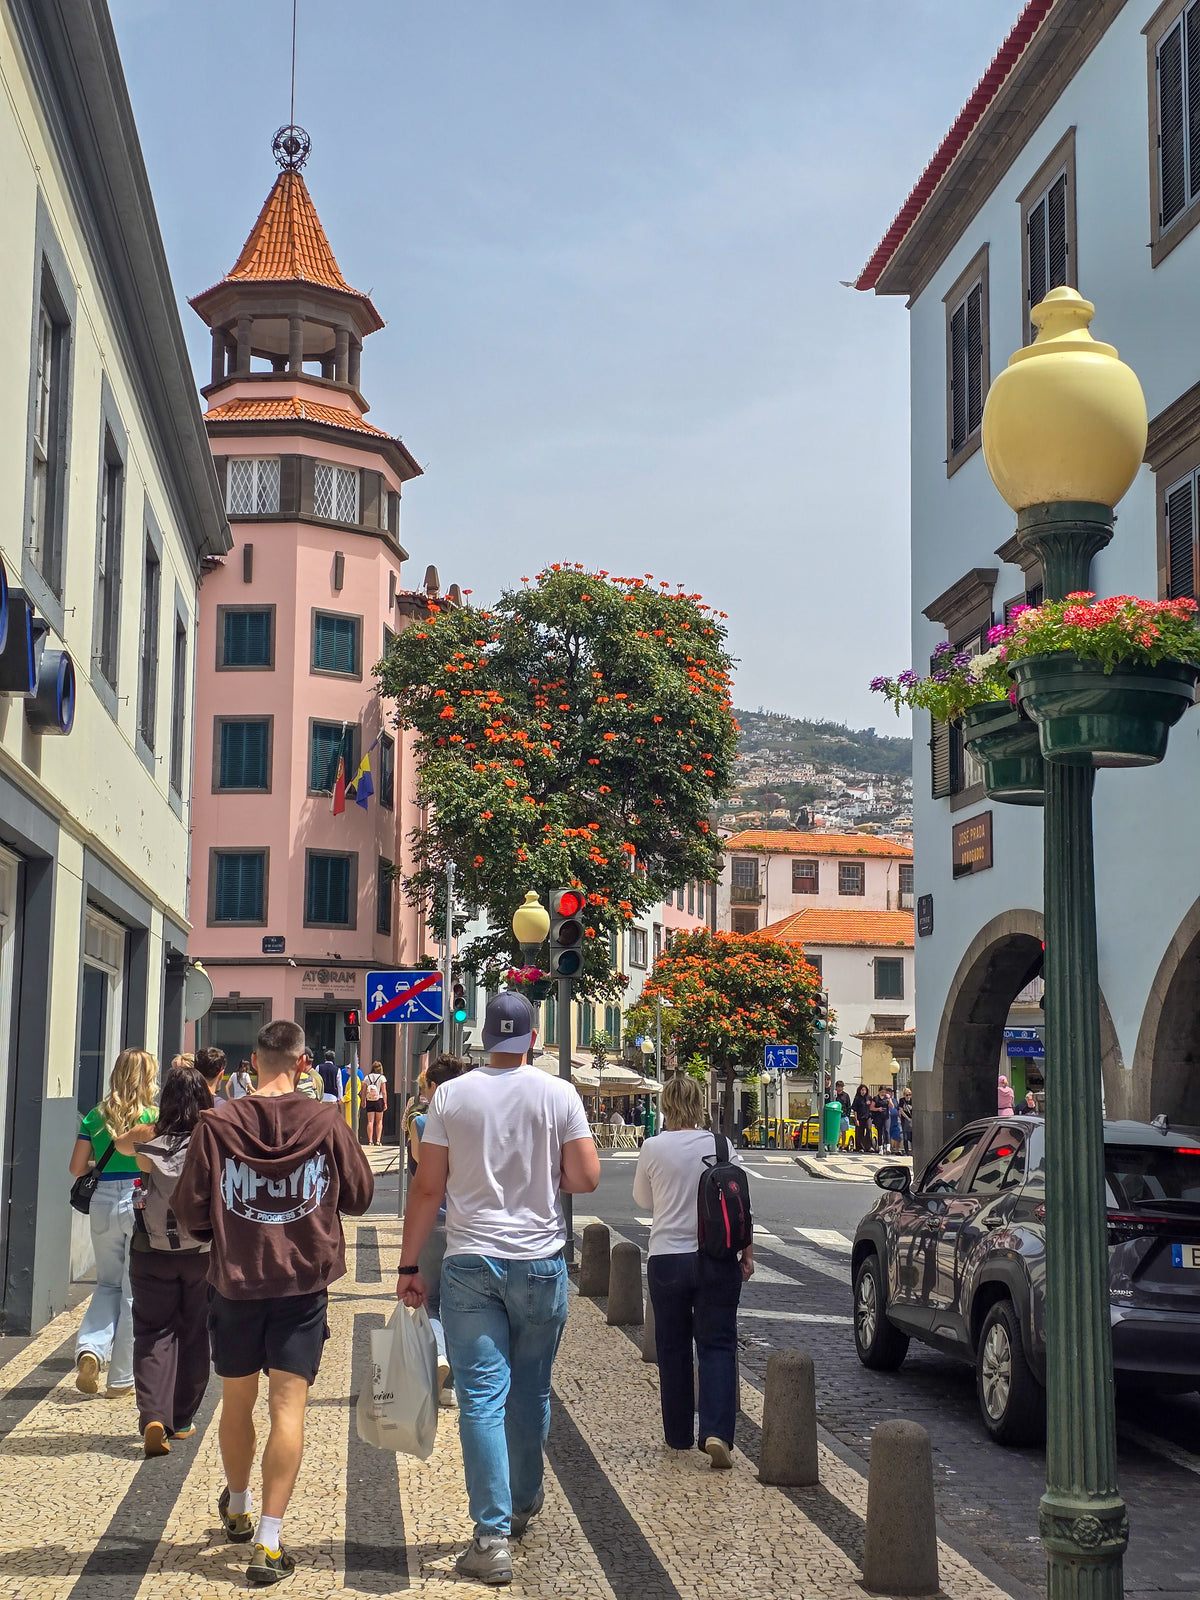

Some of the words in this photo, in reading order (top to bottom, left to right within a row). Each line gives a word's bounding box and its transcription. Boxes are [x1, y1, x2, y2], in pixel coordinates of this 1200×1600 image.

[958, 827, 970, 846] JOSÉ
[970, 824, 985, 842] PRADA
[256, 1211, 296, 1222] PROGRESS
